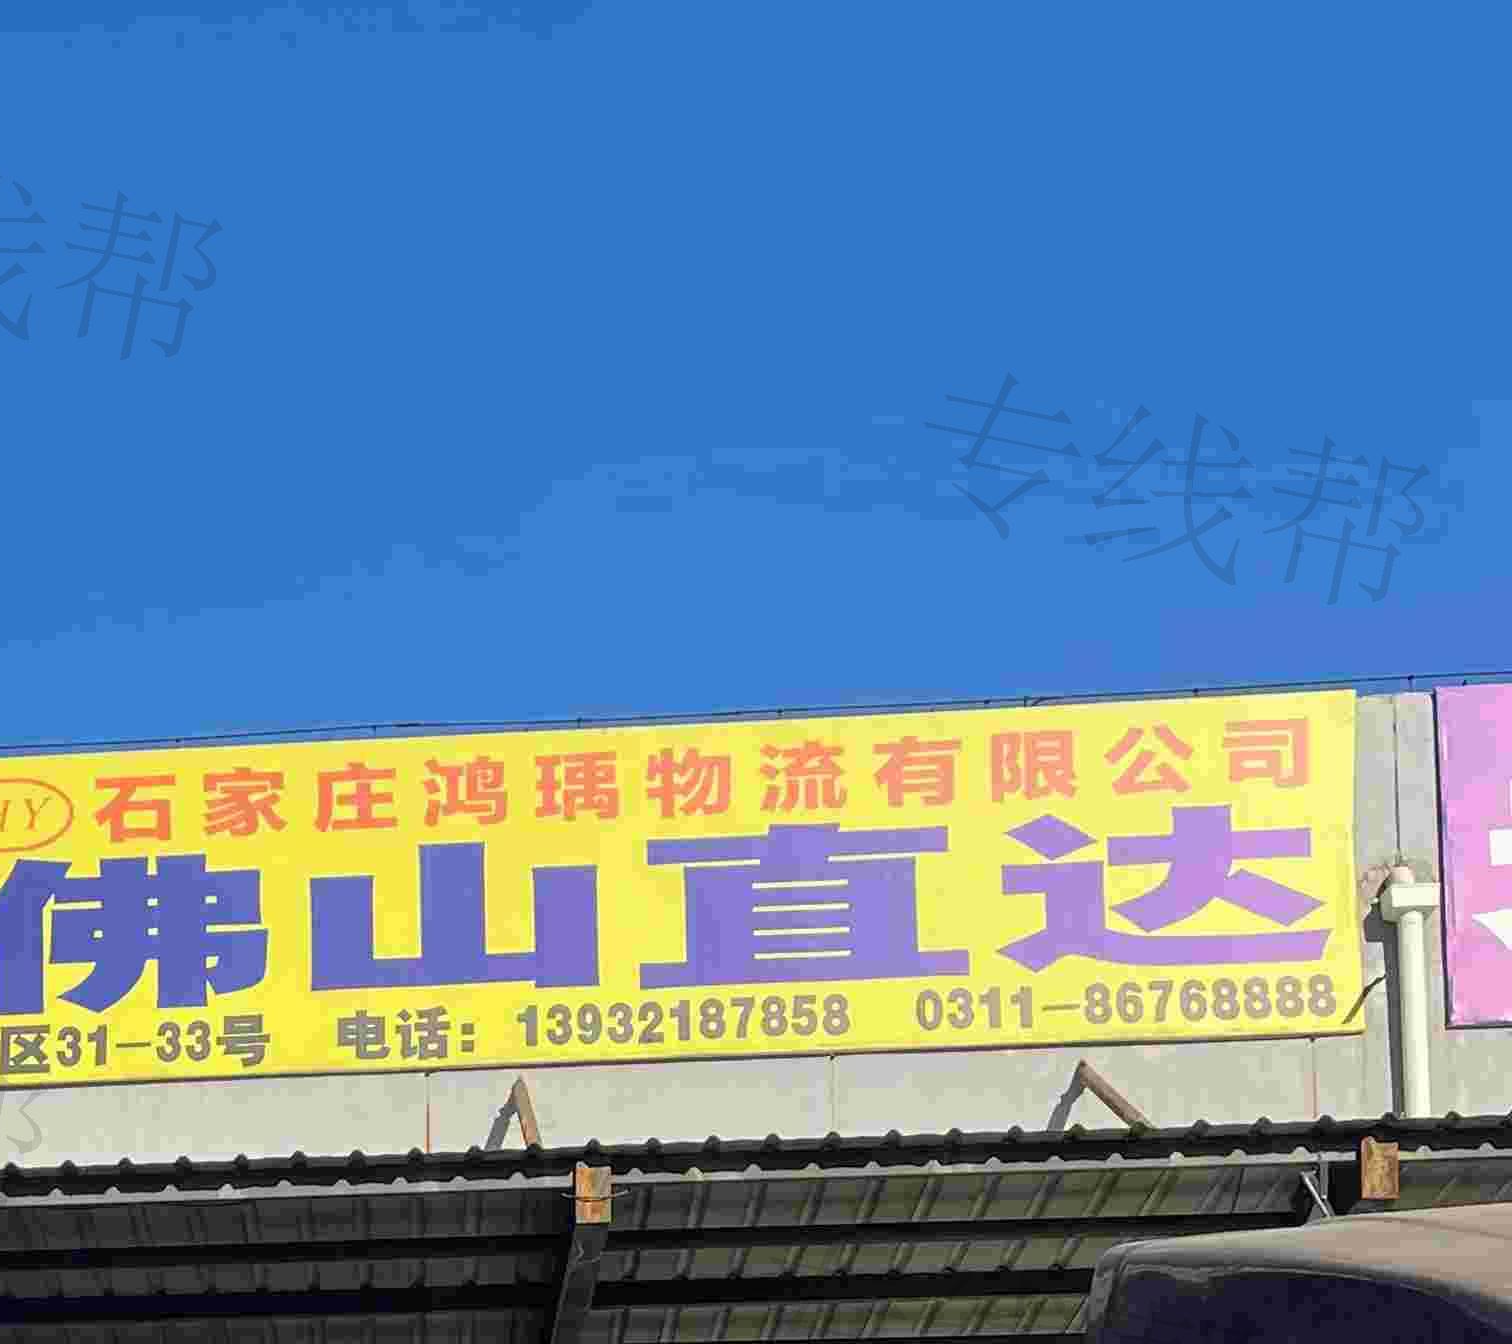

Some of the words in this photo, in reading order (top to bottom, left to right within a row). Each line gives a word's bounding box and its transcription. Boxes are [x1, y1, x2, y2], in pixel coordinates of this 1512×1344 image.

[94, 717, 1311, 843] 石家庄鸿瑀物流有限公司
[337, 1007, 476, 1062] 电话：
[516, 993, 851, 1049] 13932187858
[917, 973, 1337, 1032] 0311-86768888
